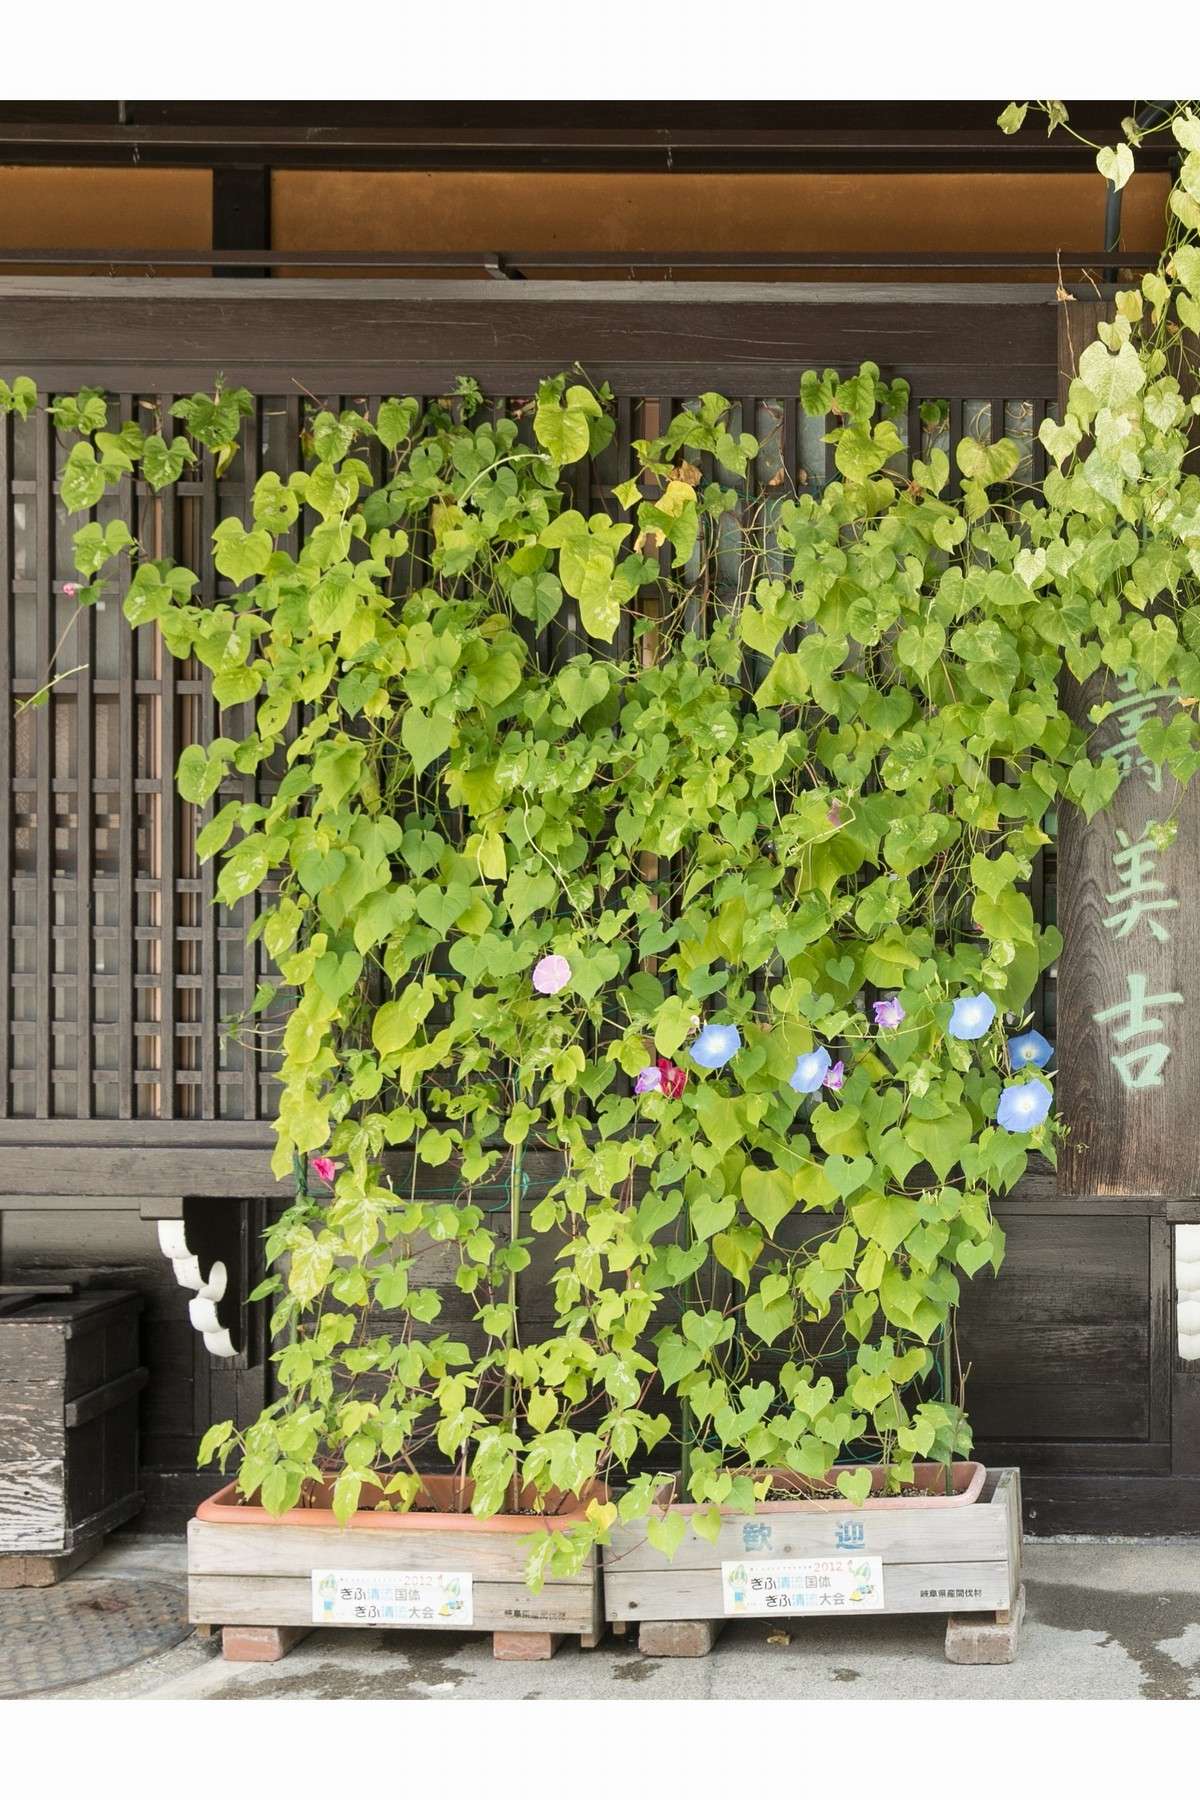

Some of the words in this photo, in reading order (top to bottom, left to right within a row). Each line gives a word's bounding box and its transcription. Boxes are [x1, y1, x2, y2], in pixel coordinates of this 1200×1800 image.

[743, 1520, 866, 1551] 歓迎
[814, 1562, 844, 1572] 2012
[404, 1575, 433, 1586] 2012
